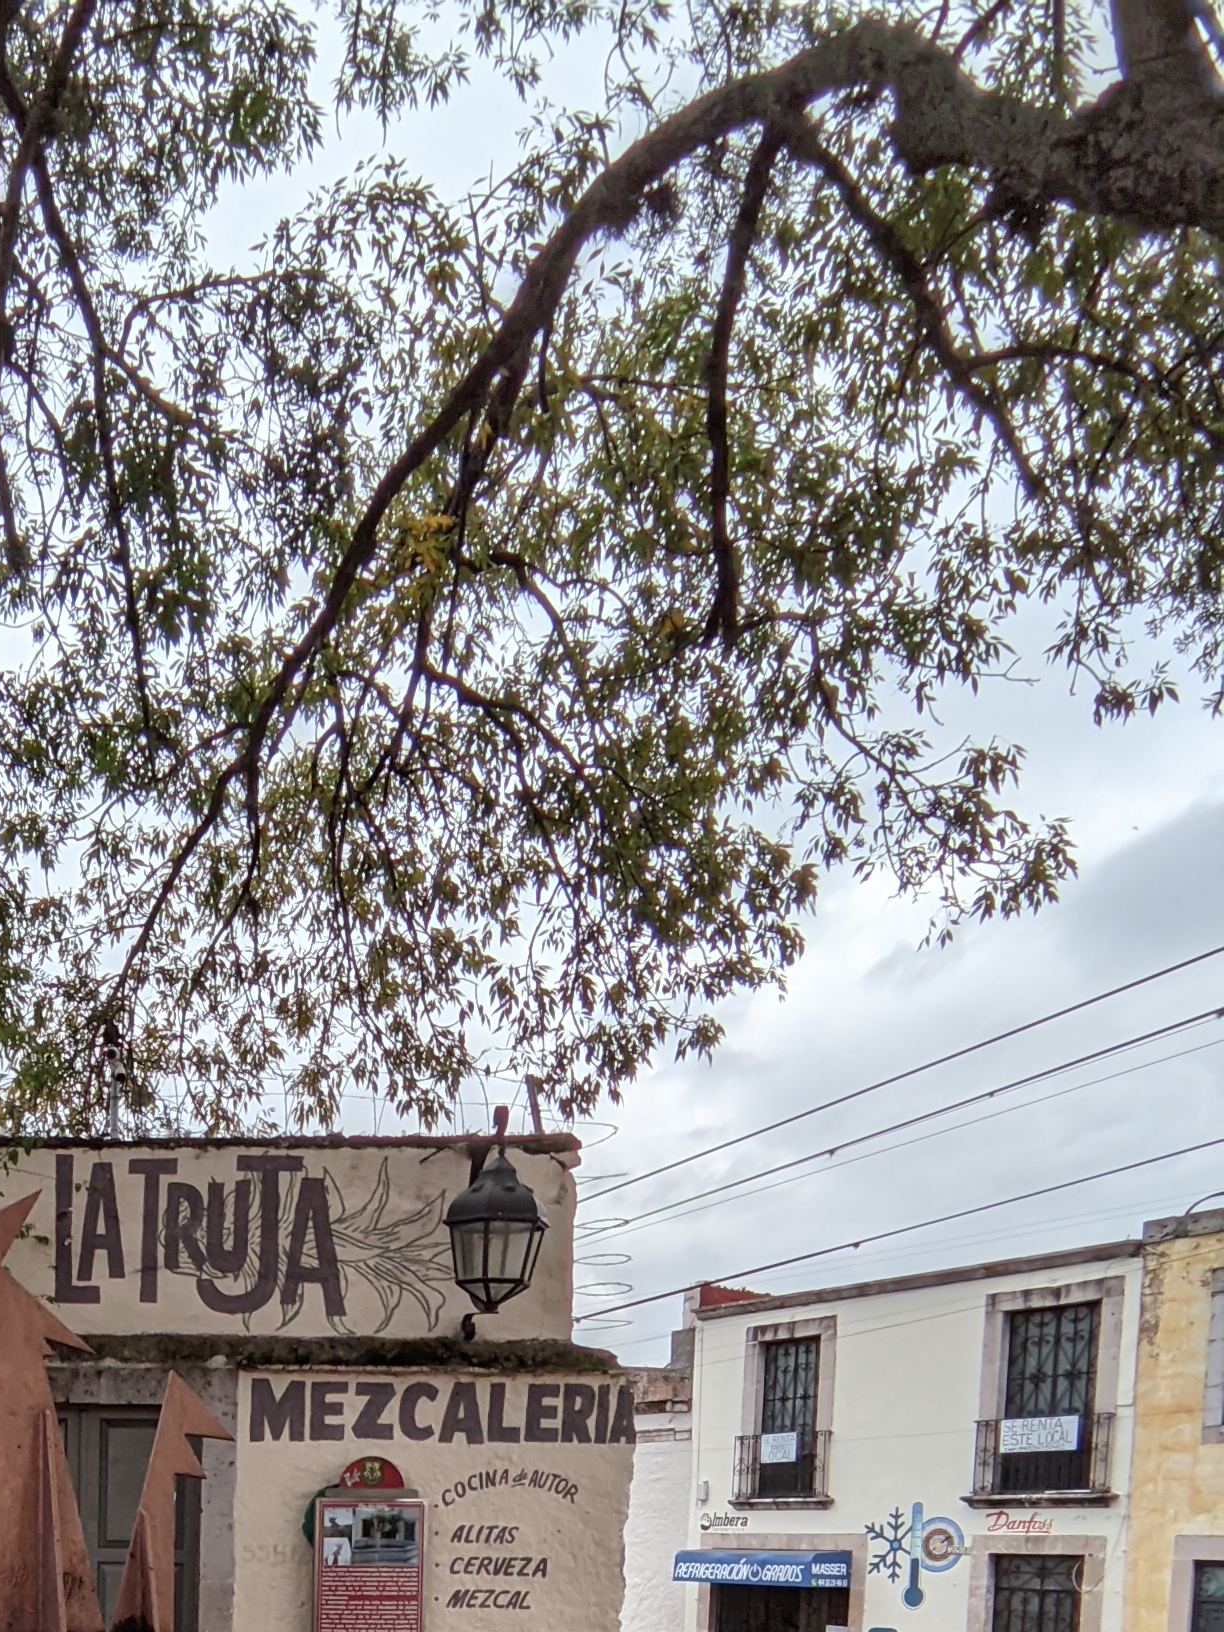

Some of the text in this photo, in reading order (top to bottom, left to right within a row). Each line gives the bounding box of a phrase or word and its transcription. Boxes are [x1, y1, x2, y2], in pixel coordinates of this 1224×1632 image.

[55, 1154, 347, 1317] LA TRUJA
[249, 1378, 636, 1444] MEZCALERIA
[1003, 1417, 1064, 1434] SE RENTA
[763, 1434, 796, 1444] SE RENTA
[1002, 1430, 1073, 1446] ESTE LOCAL
[762, 1450, 794, 1462] LOCAL
[441, 1467, 579, 1507] COCINA de AUTOR
[710, 1511, 749, 1527] Imbera
[985, 1510, 1055, 1535] Danfoss
[450, 1524, 520, 1545] ALITAS
[449, 1556, 548, 1579] CERVEZA
[675, 1558, 805, 1583] REFRIGERACIÓN GRADOS
[811, 1563, 847, 1576] MASSER
[445, 1589, 532, 1610] MEZCAL
